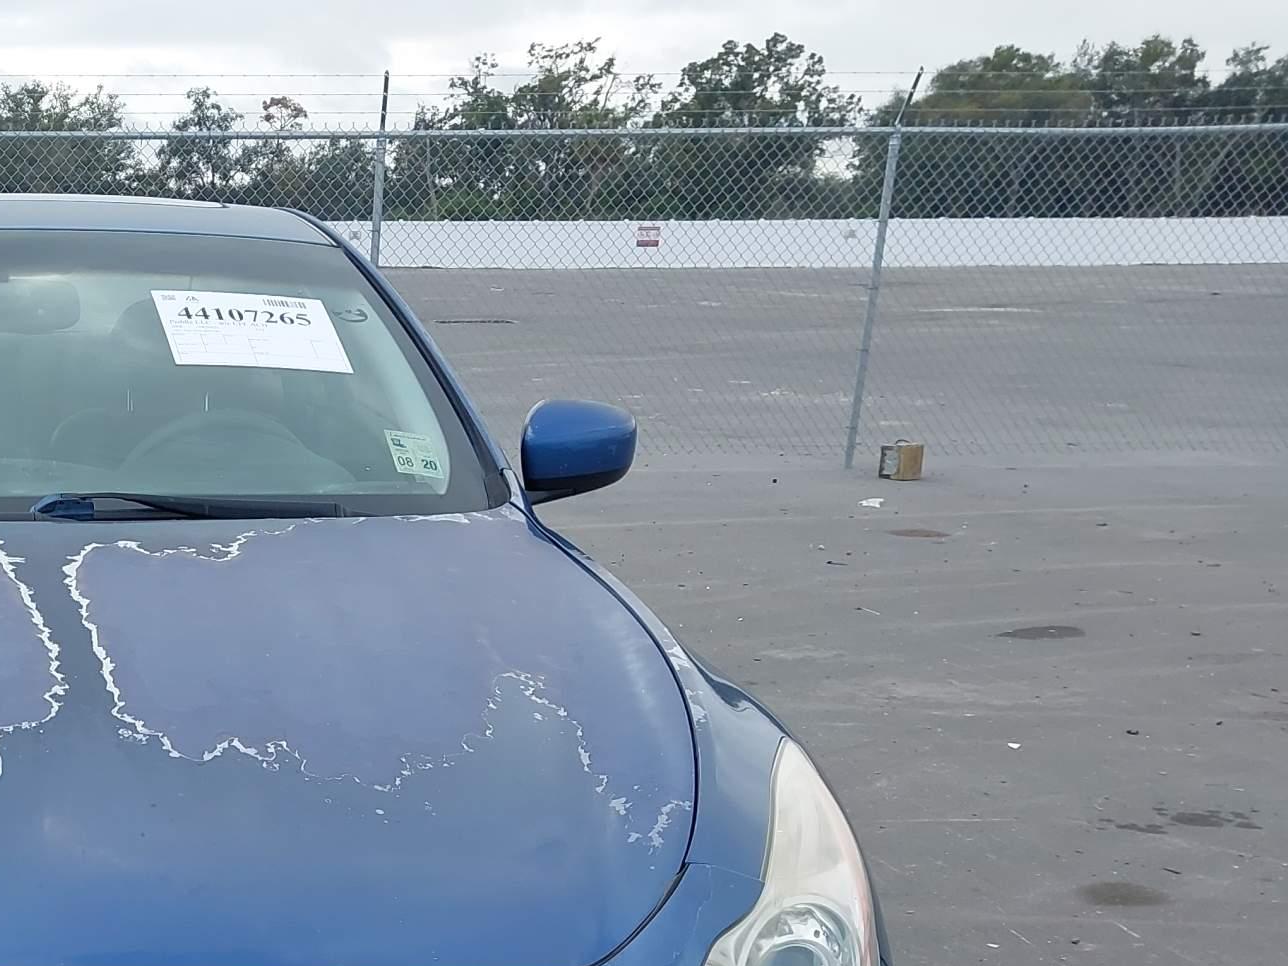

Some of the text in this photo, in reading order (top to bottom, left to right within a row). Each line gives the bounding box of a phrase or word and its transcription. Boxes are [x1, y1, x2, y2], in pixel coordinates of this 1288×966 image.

[178, 306, 311, 326] 44107265
[397, 455, 438, 471] 08 20
